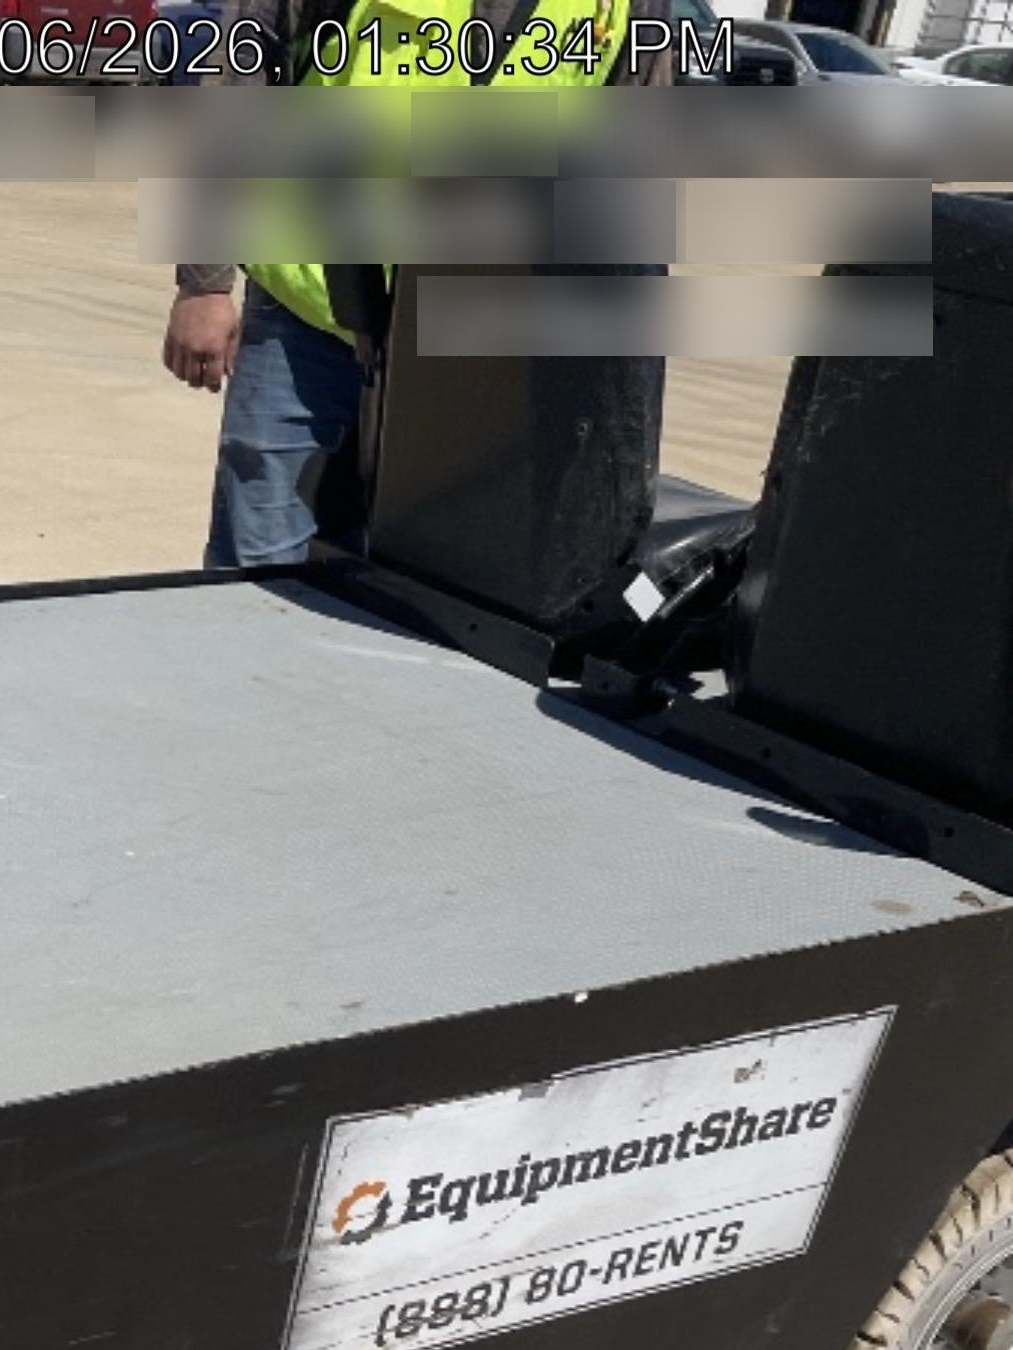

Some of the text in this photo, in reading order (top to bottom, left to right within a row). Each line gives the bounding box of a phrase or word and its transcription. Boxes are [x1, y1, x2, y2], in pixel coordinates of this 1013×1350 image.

[398, 1096, 837, 1226] EquipmentShare
[374, 1221, 744, 1347] (888) 80-RENTS
